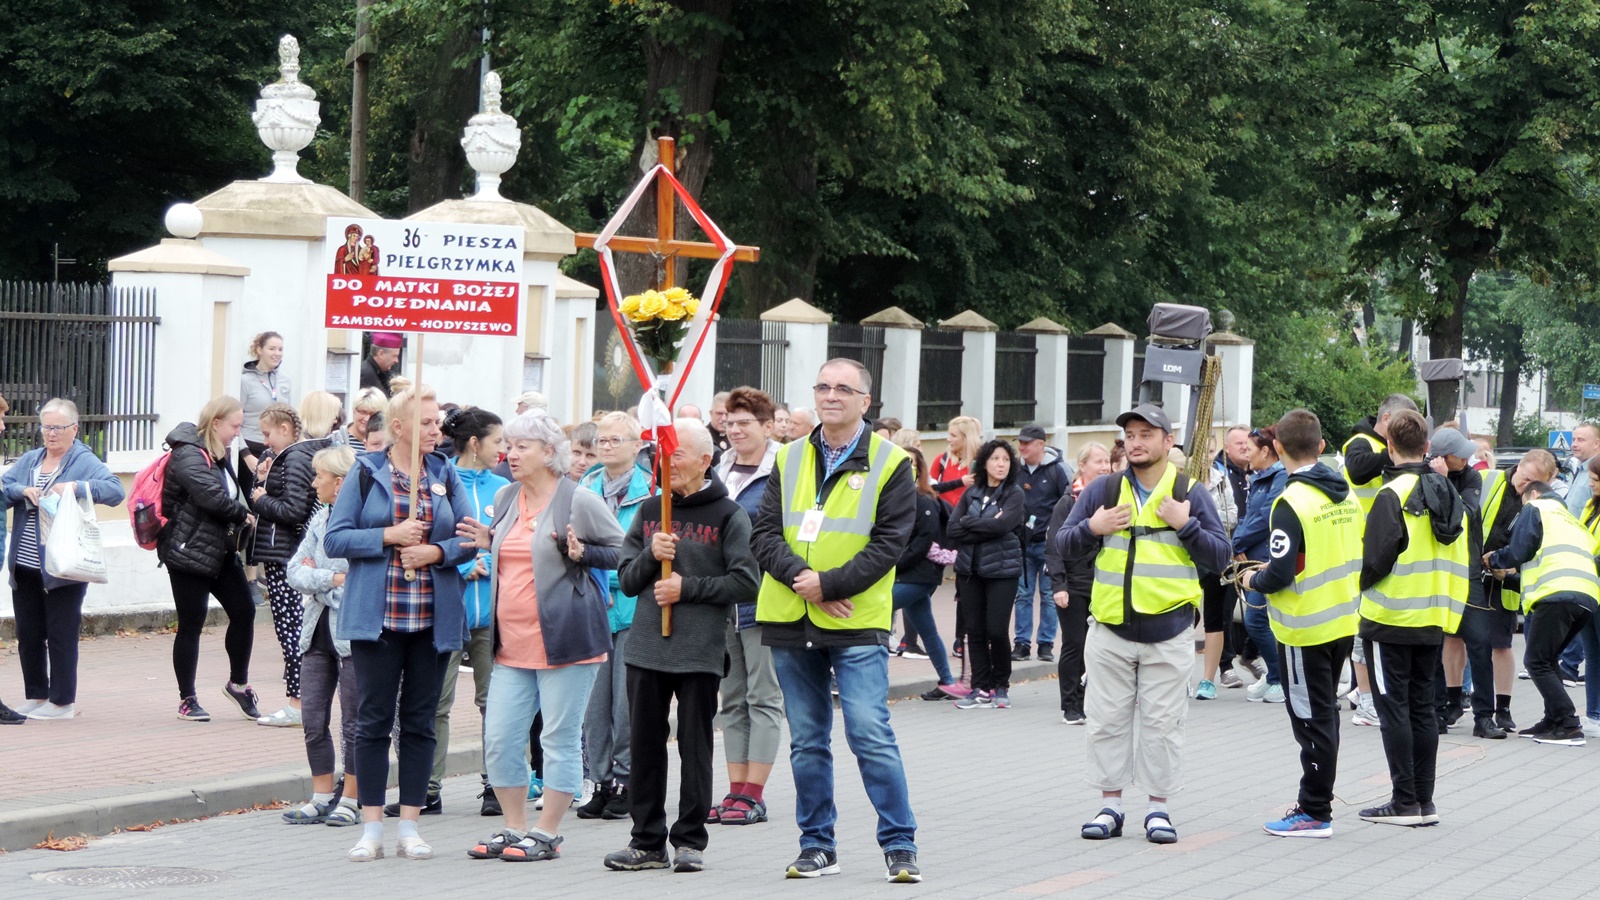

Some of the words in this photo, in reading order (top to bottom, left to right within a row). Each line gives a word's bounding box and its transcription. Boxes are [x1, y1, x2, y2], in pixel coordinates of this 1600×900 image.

[443, 234, 517, 249] PIESZA
[386, 254, 516, 273] PIELGRZYMKA
[332, 278, 363, 291] DO
[375, 280, 439, 294] MATKI
[452, 282, 515, 298] BOŻEJ
[352, 295, 492, 313] POJEDNANIA
[331, 314, 407, 327] ZAMBRÓW
[420, 319, 512, 332] HODYSZEWO
[1162, 364, 1182, 374] LDM
